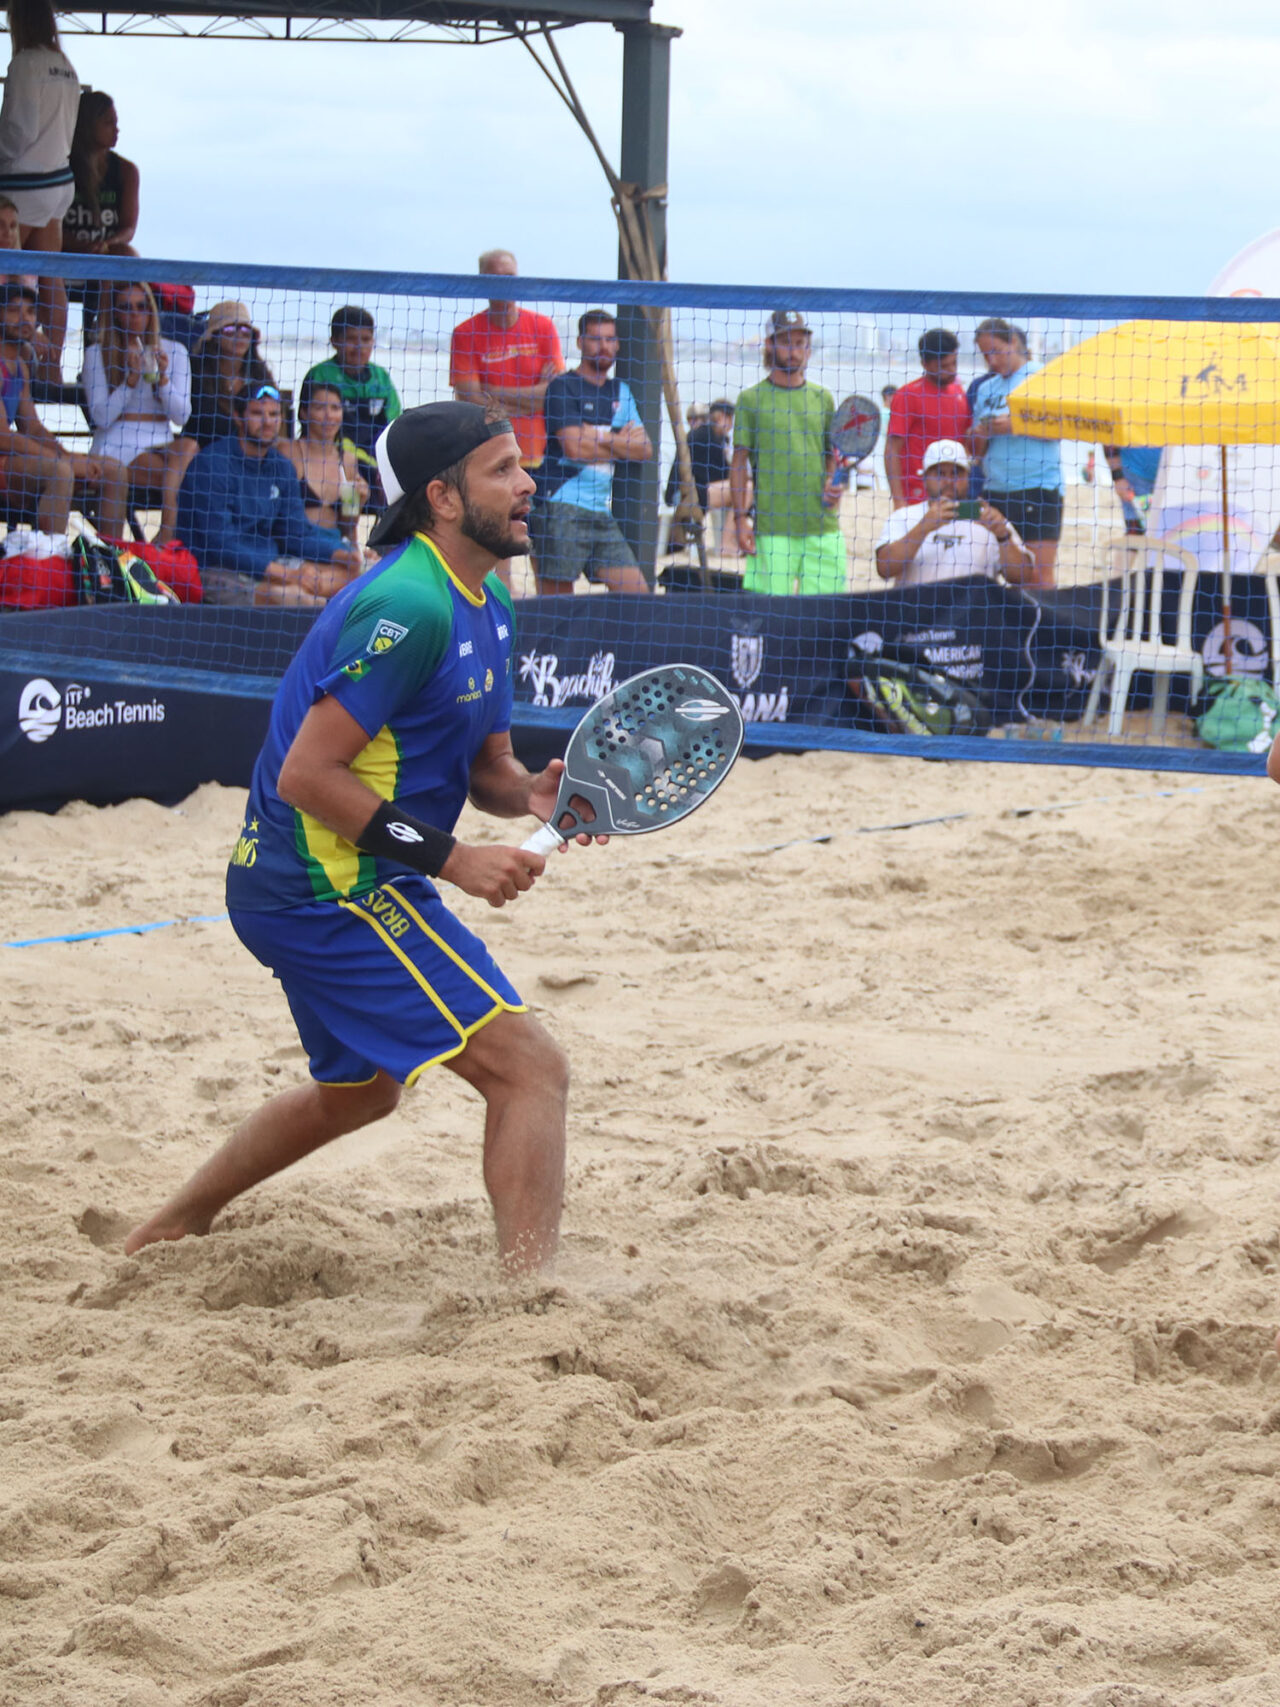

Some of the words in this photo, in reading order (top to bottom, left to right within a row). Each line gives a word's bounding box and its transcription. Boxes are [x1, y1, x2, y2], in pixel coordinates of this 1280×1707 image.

[379, 625, 402, 640] CBT
[65, 702, 114, 730] Beach
[115, 698, 166, 724] Tennis
